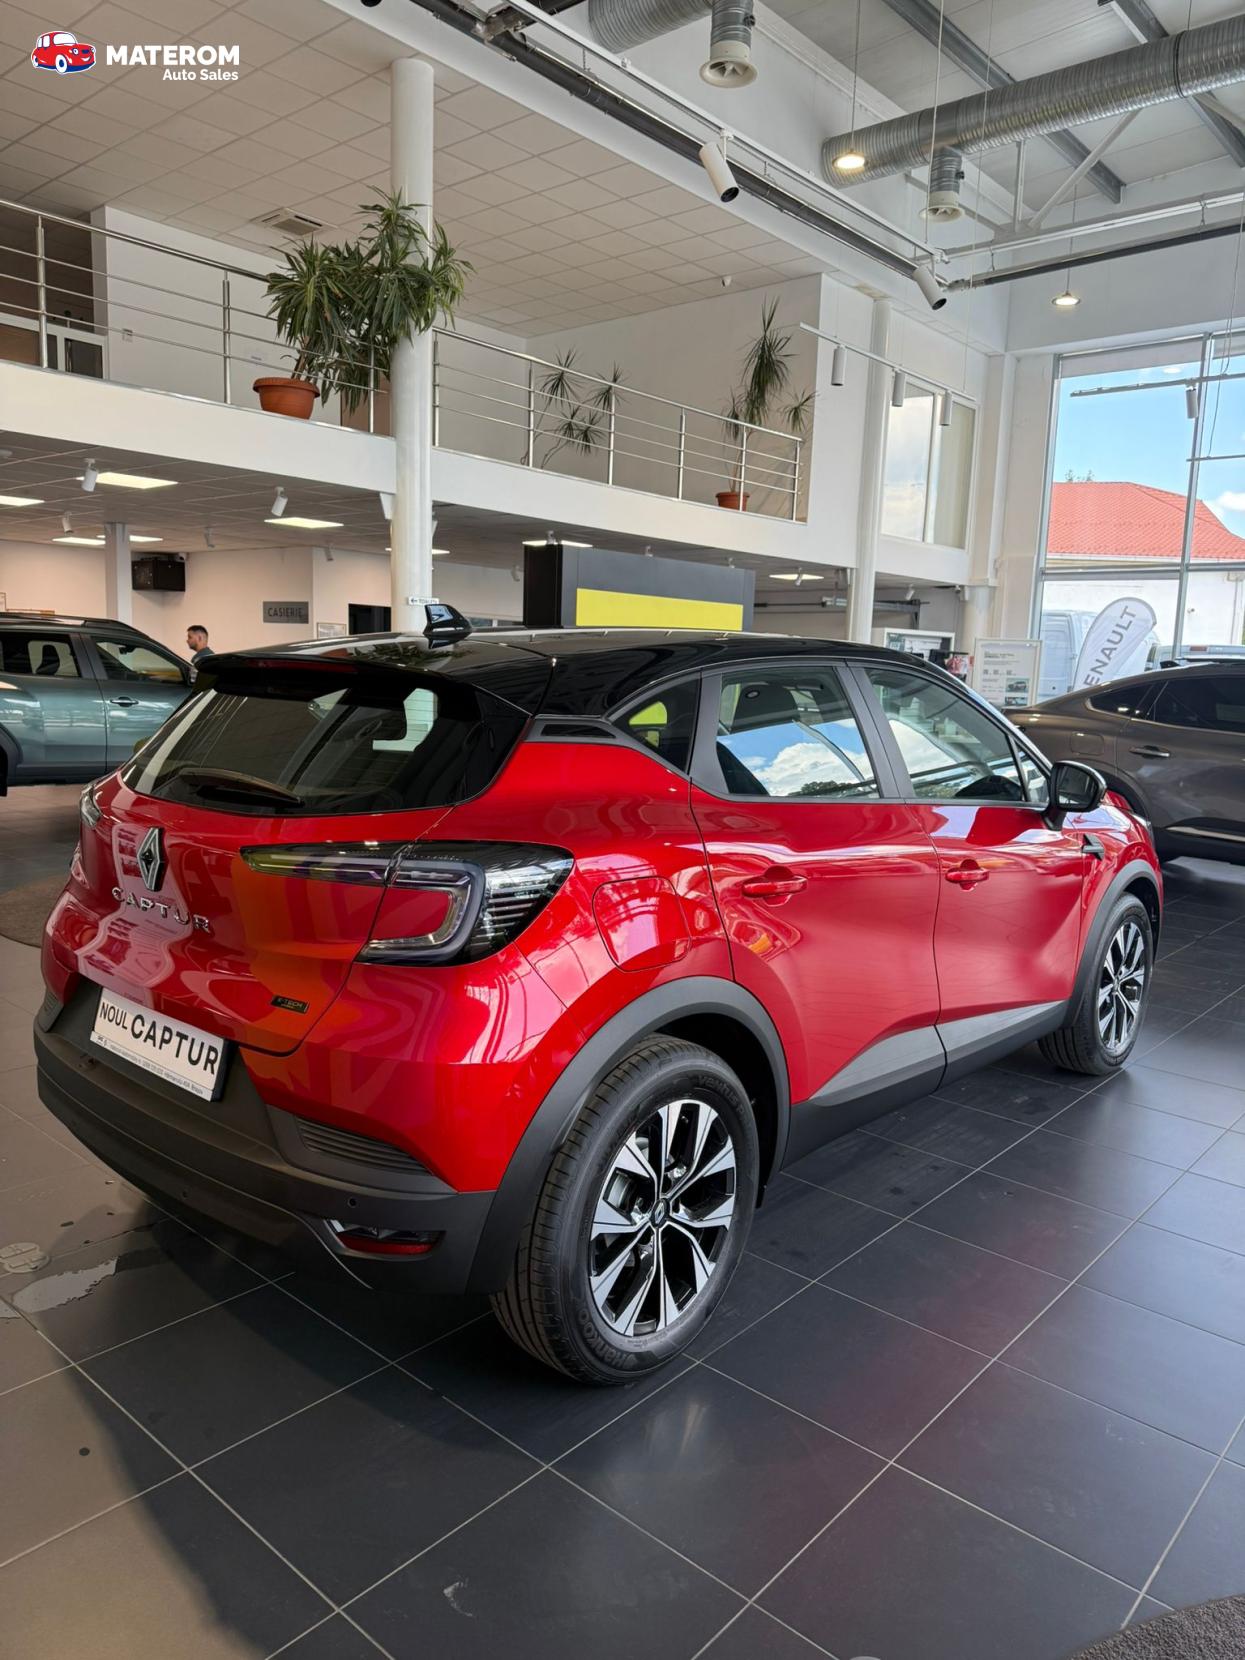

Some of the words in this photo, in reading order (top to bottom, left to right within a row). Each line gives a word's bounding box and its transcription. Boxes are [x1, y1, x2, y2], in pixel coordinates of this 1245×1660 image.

[1083, 605, 1136, 686] ENAULT
[111, 887, 211, 933] CAPTUR
[100, 1001, 128, 1031] NOUL
[130, 1014, 219, 1075] CAPTUR
